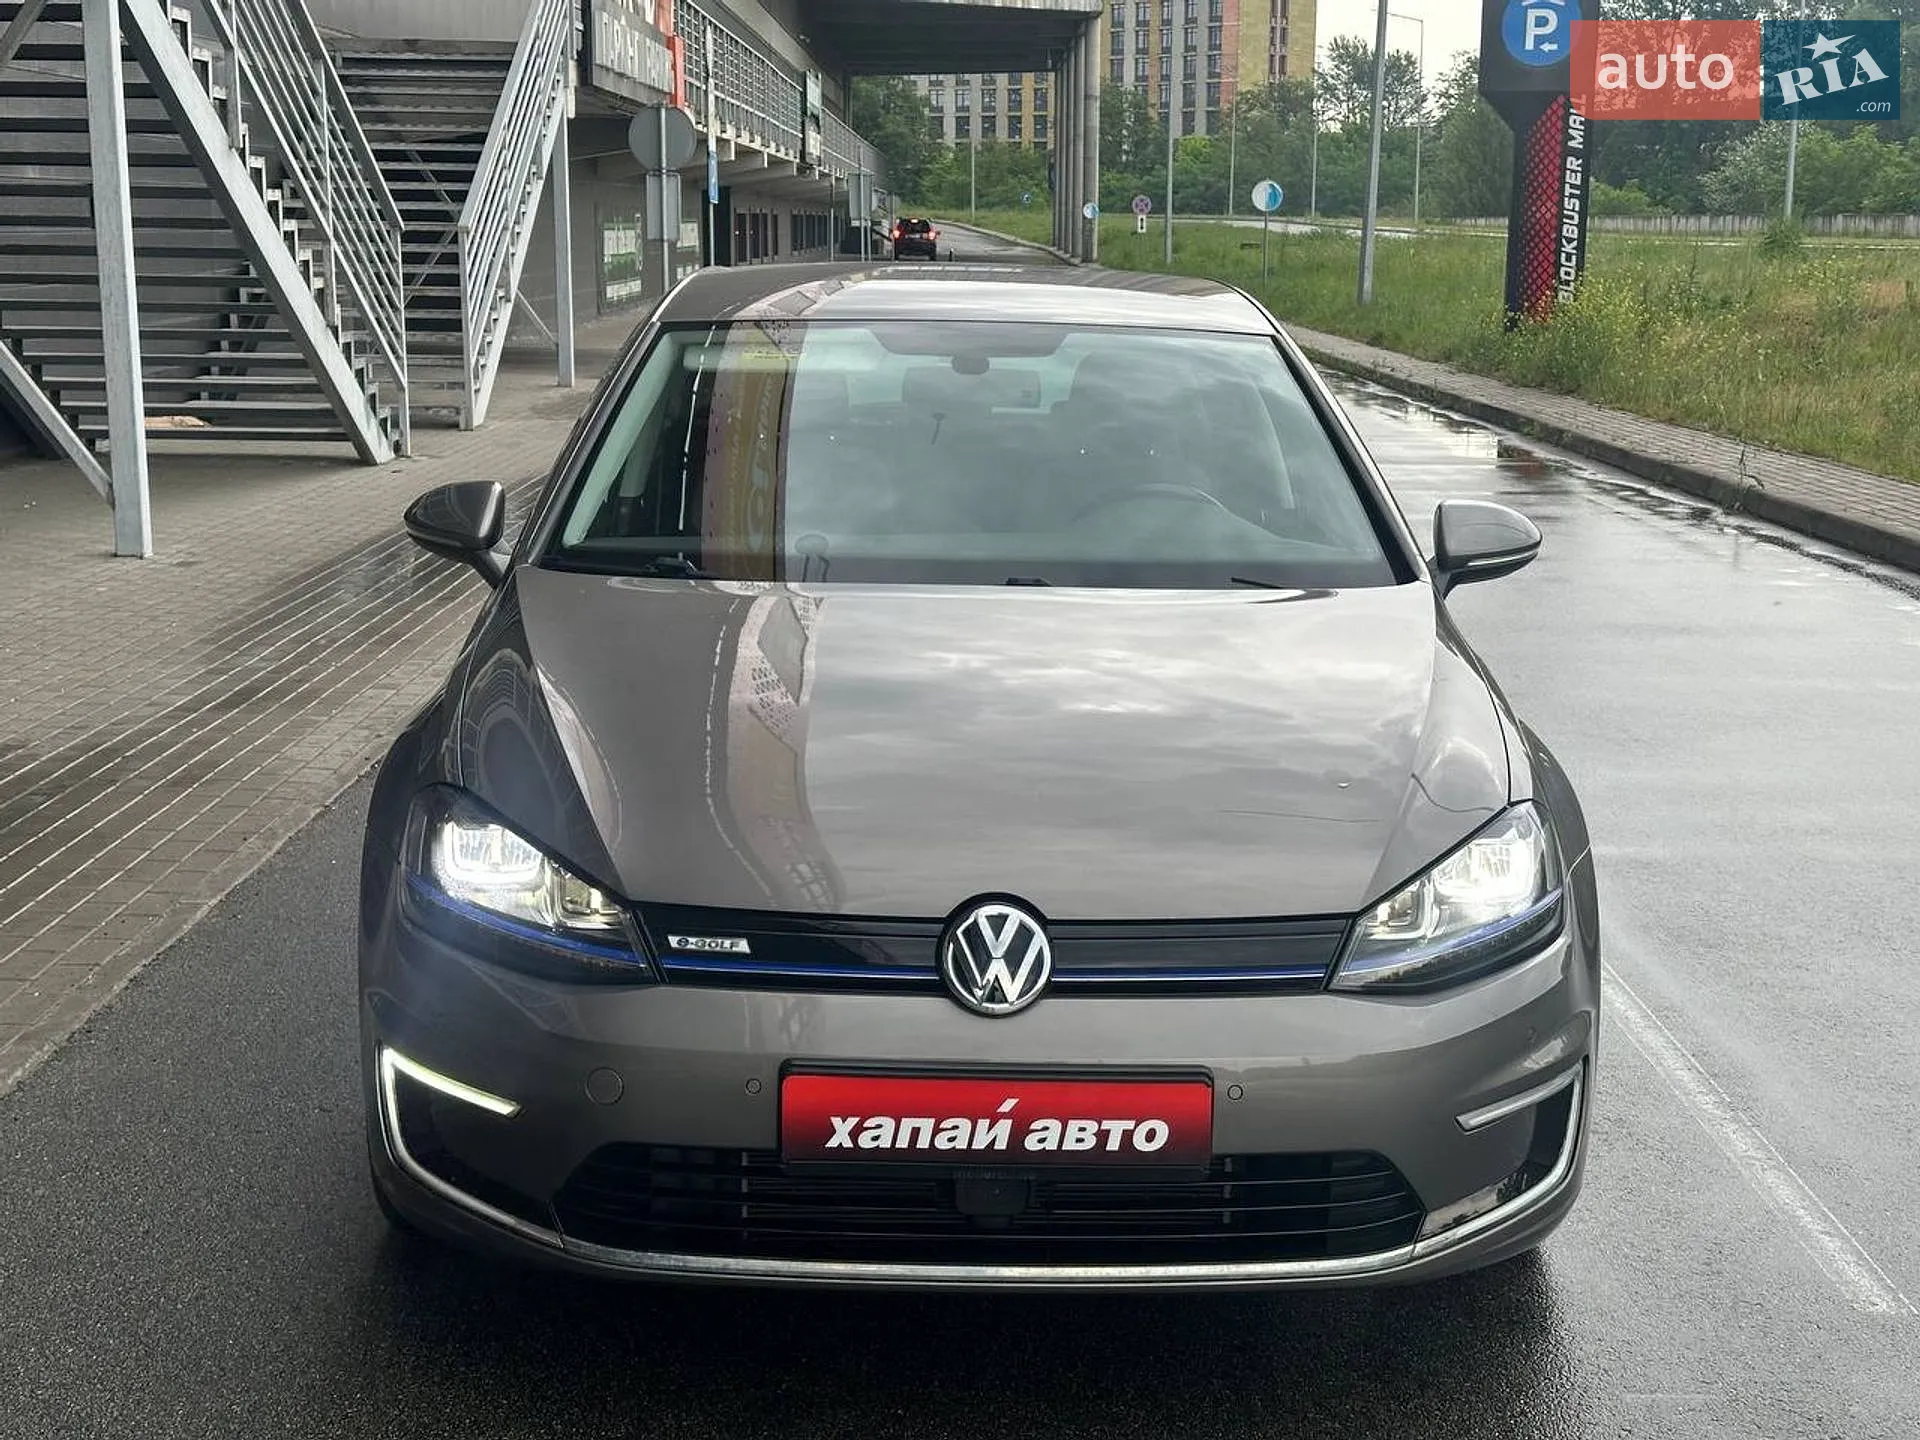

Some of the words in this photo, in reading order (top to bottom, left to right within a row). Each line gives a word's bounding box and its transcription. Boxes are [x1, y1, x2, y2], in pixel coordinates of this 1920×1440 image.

[1525, 8, 1557, 51] P
[1557, 155, 1583, 304] BLOCKBUSTER
[1024, 1117, 1170, 1153] авто
